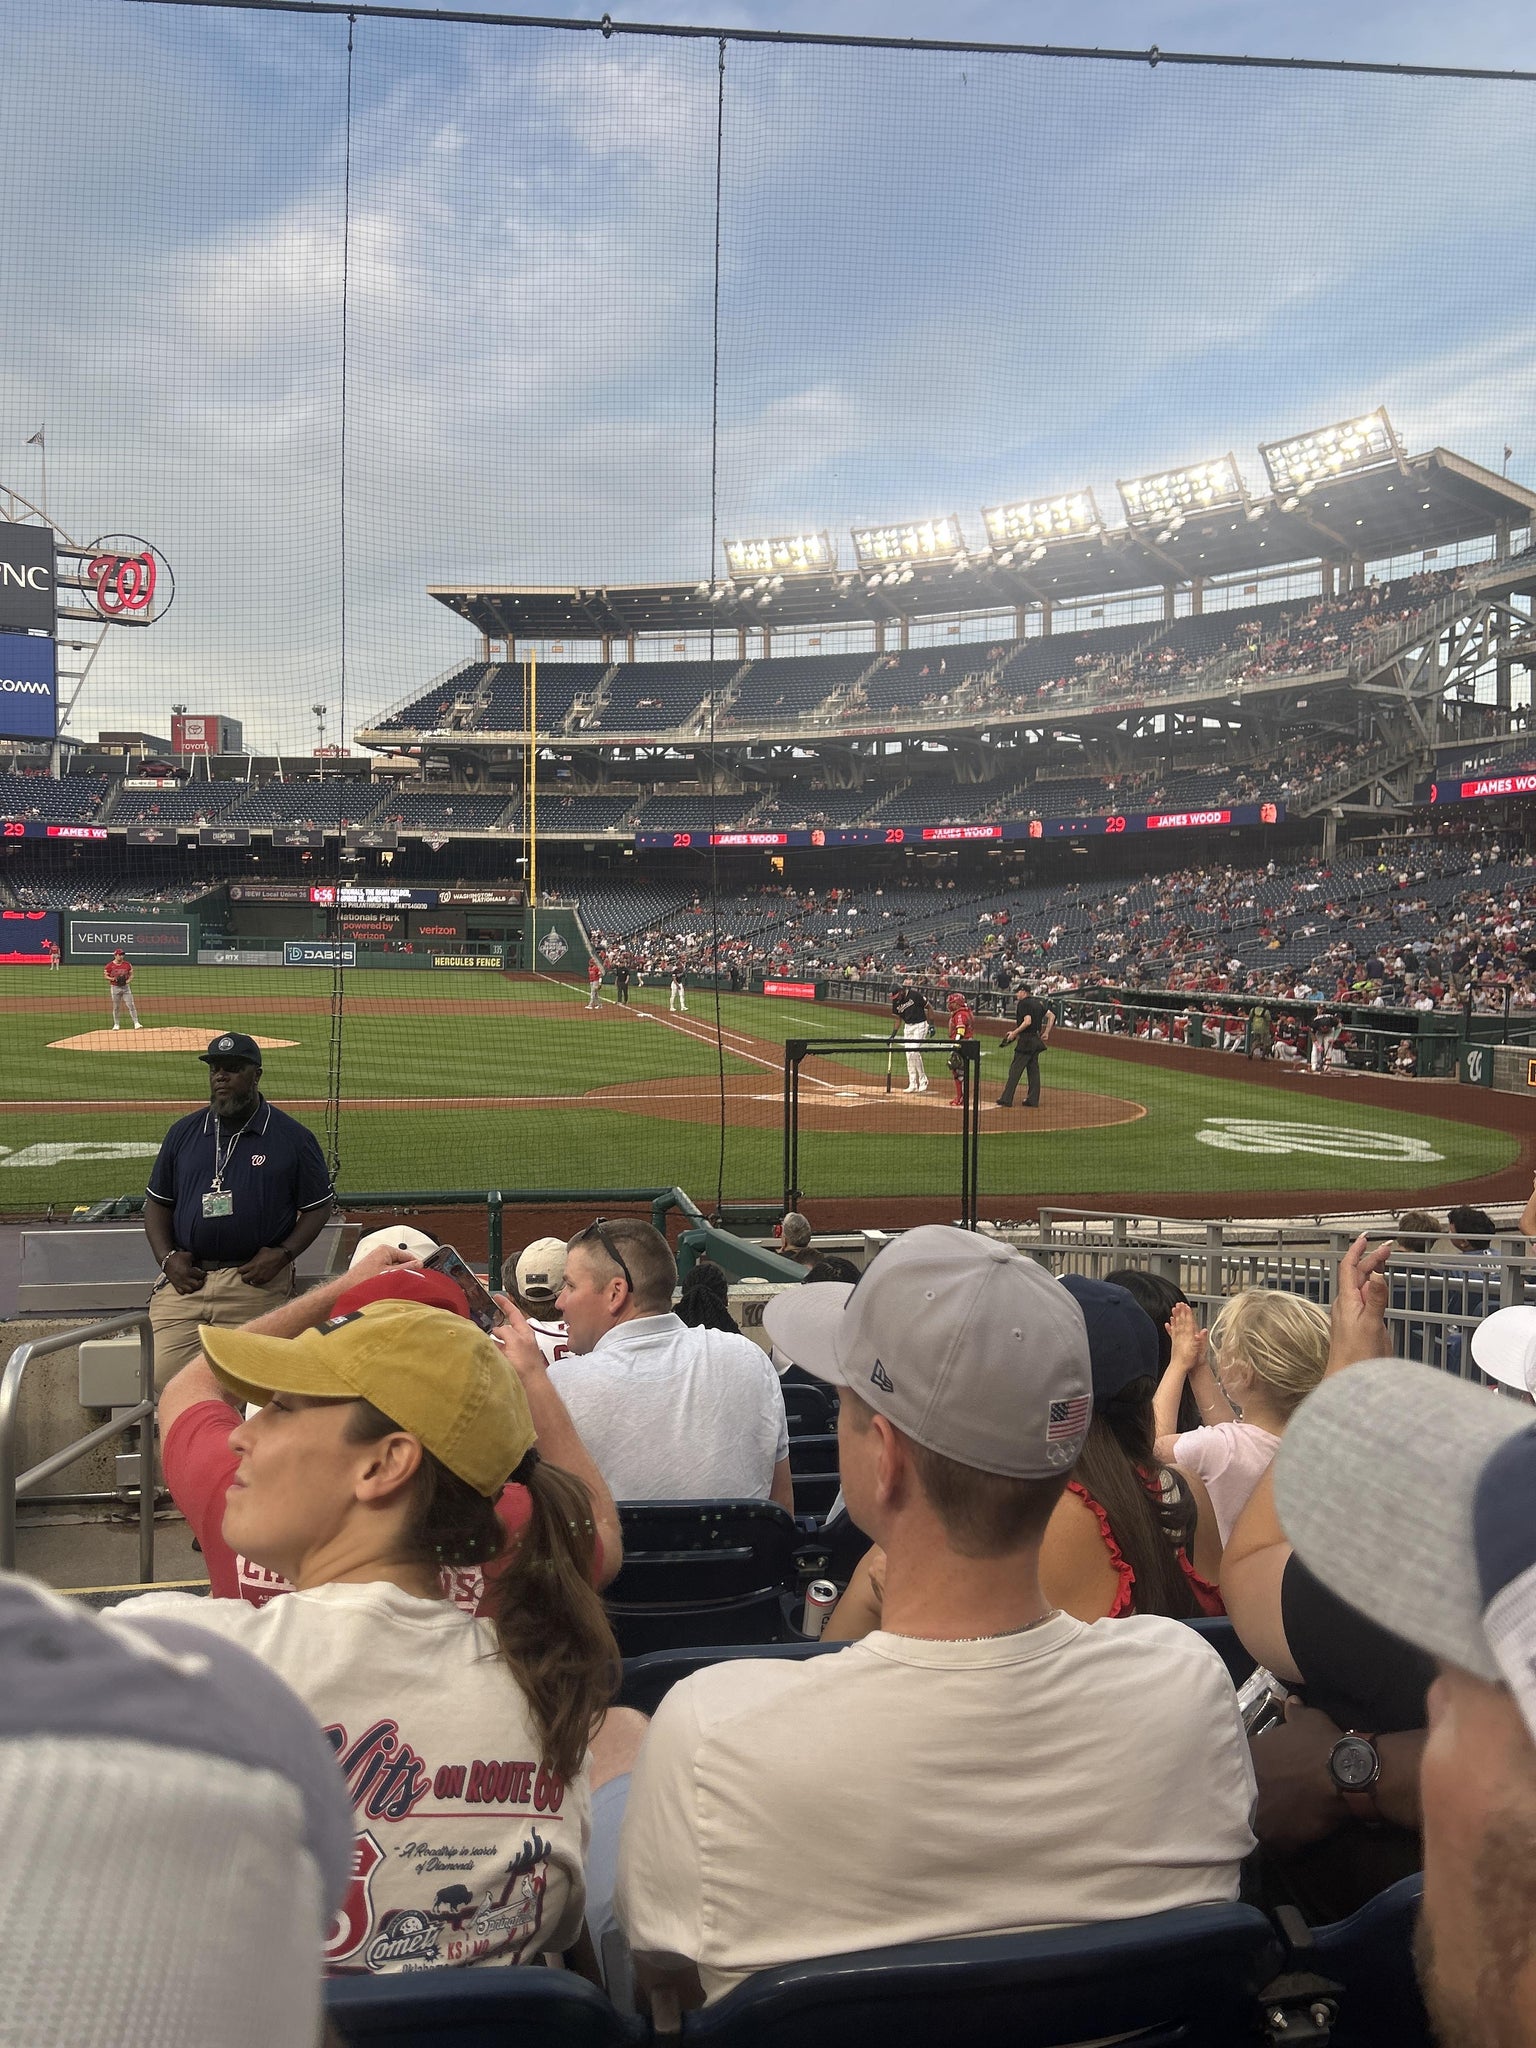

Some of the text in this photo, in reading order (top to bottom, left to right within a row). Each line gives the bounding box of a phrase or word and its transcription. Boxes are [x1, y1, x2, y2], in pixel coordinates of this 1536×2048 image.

[0, 561, 49, 590] NC
[1474, 781, 1513, 795] JAMES
[1105, 816, 1126, 833] 29
[1157, 812, 1222, 827] JAMES WOOD
[3, 822, 25, 837] 29
[58, 828, 89, 837] JAMES
[885, 828, 905, 843] 29
[932, 826, 994, 840] JAMES WOOD
[673, 833, 691, 847] 29
[718, 834, 779, 844] JAMES WOOD
[313, 889, 334, 901] 6:56
[453, 892, 494, 900] WASHINGTON
[343, 922, 394, 931] powered by
[419, 925, 456, 935] verizon
[78, 933, 182, 944] VENTURE GLOBAL
[352, 931, 385, 940] Verizon
[304, 950, 353, 960] DABOS
[493, 944, 503, 955] 335
[434, 957, 501, 967] HERCULES FENCE
[433, 1764, 467, 1800] ON
[465, 1759, 537, 1804] ROUTE
[414, 1842, 458, 1859] Roadtrip
[459, 1845, 470, 1857] in
[470, 1844, 498, 1857] search
[415, 1856, 475, 1876] of Diamonds
[366, 1924, 438, 1970] Comets
[447, 1941, 463, 1960] KS
